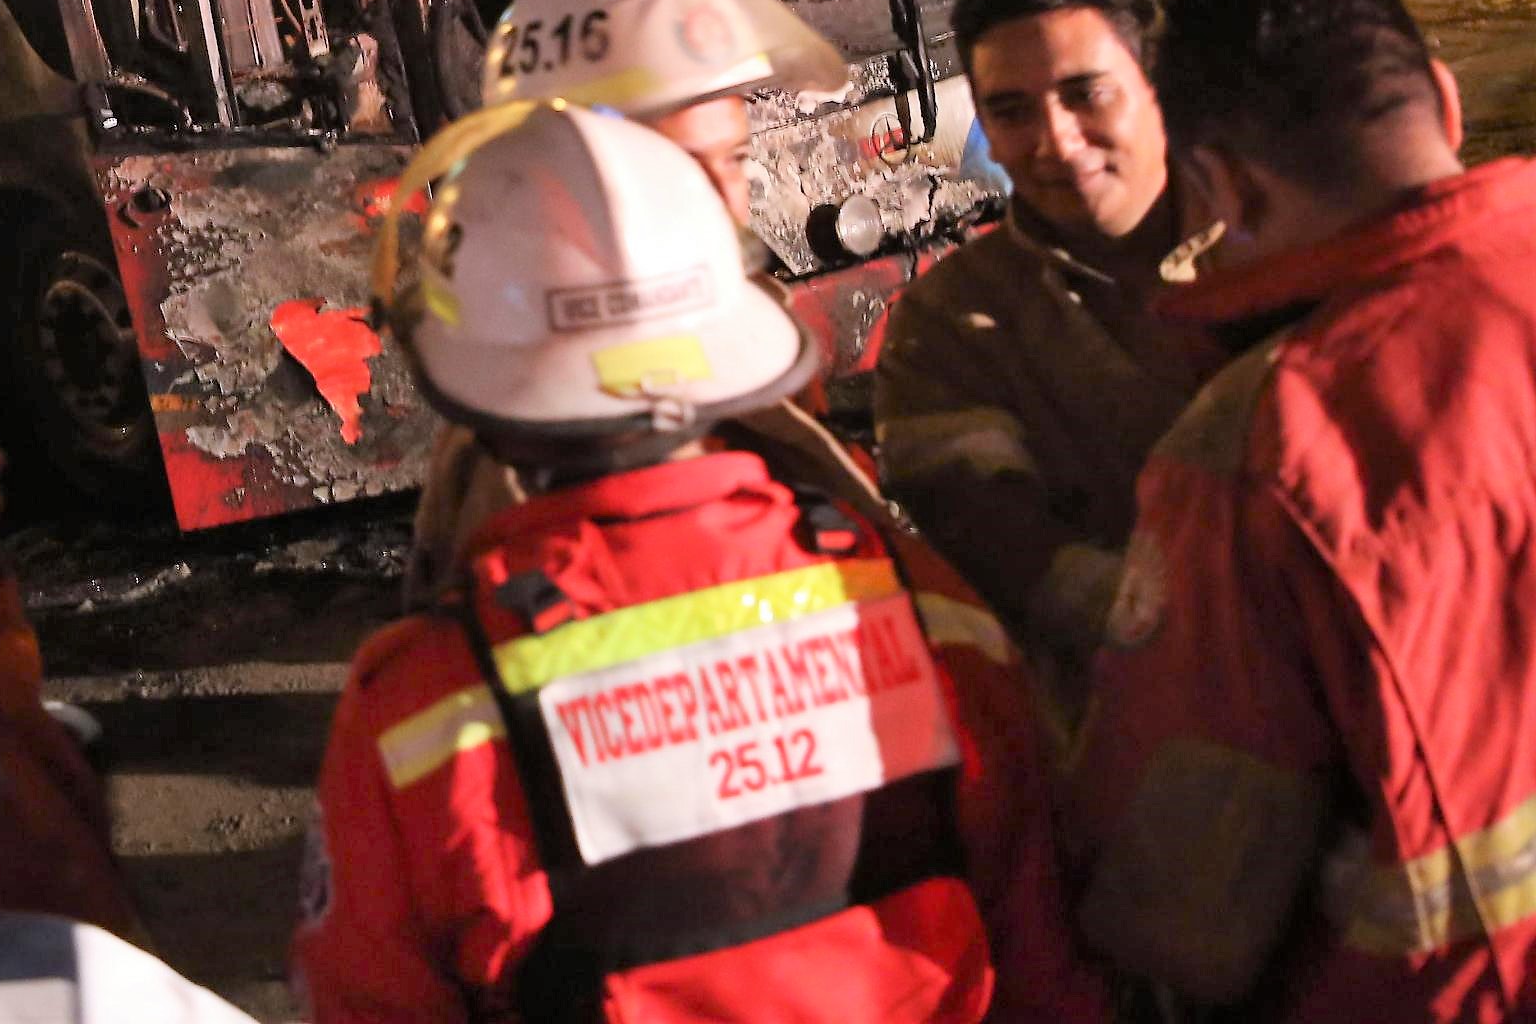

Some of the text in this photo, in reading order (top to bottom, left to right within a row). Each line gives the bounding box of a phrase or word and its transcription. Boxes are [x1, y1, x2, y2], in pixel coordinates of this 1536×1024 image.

[498, 8, 610, 78] 25.16
[555, 617, 921, 767] VICEDEPARTAMENTAL
[707, 728, 824, 801] 25.12
